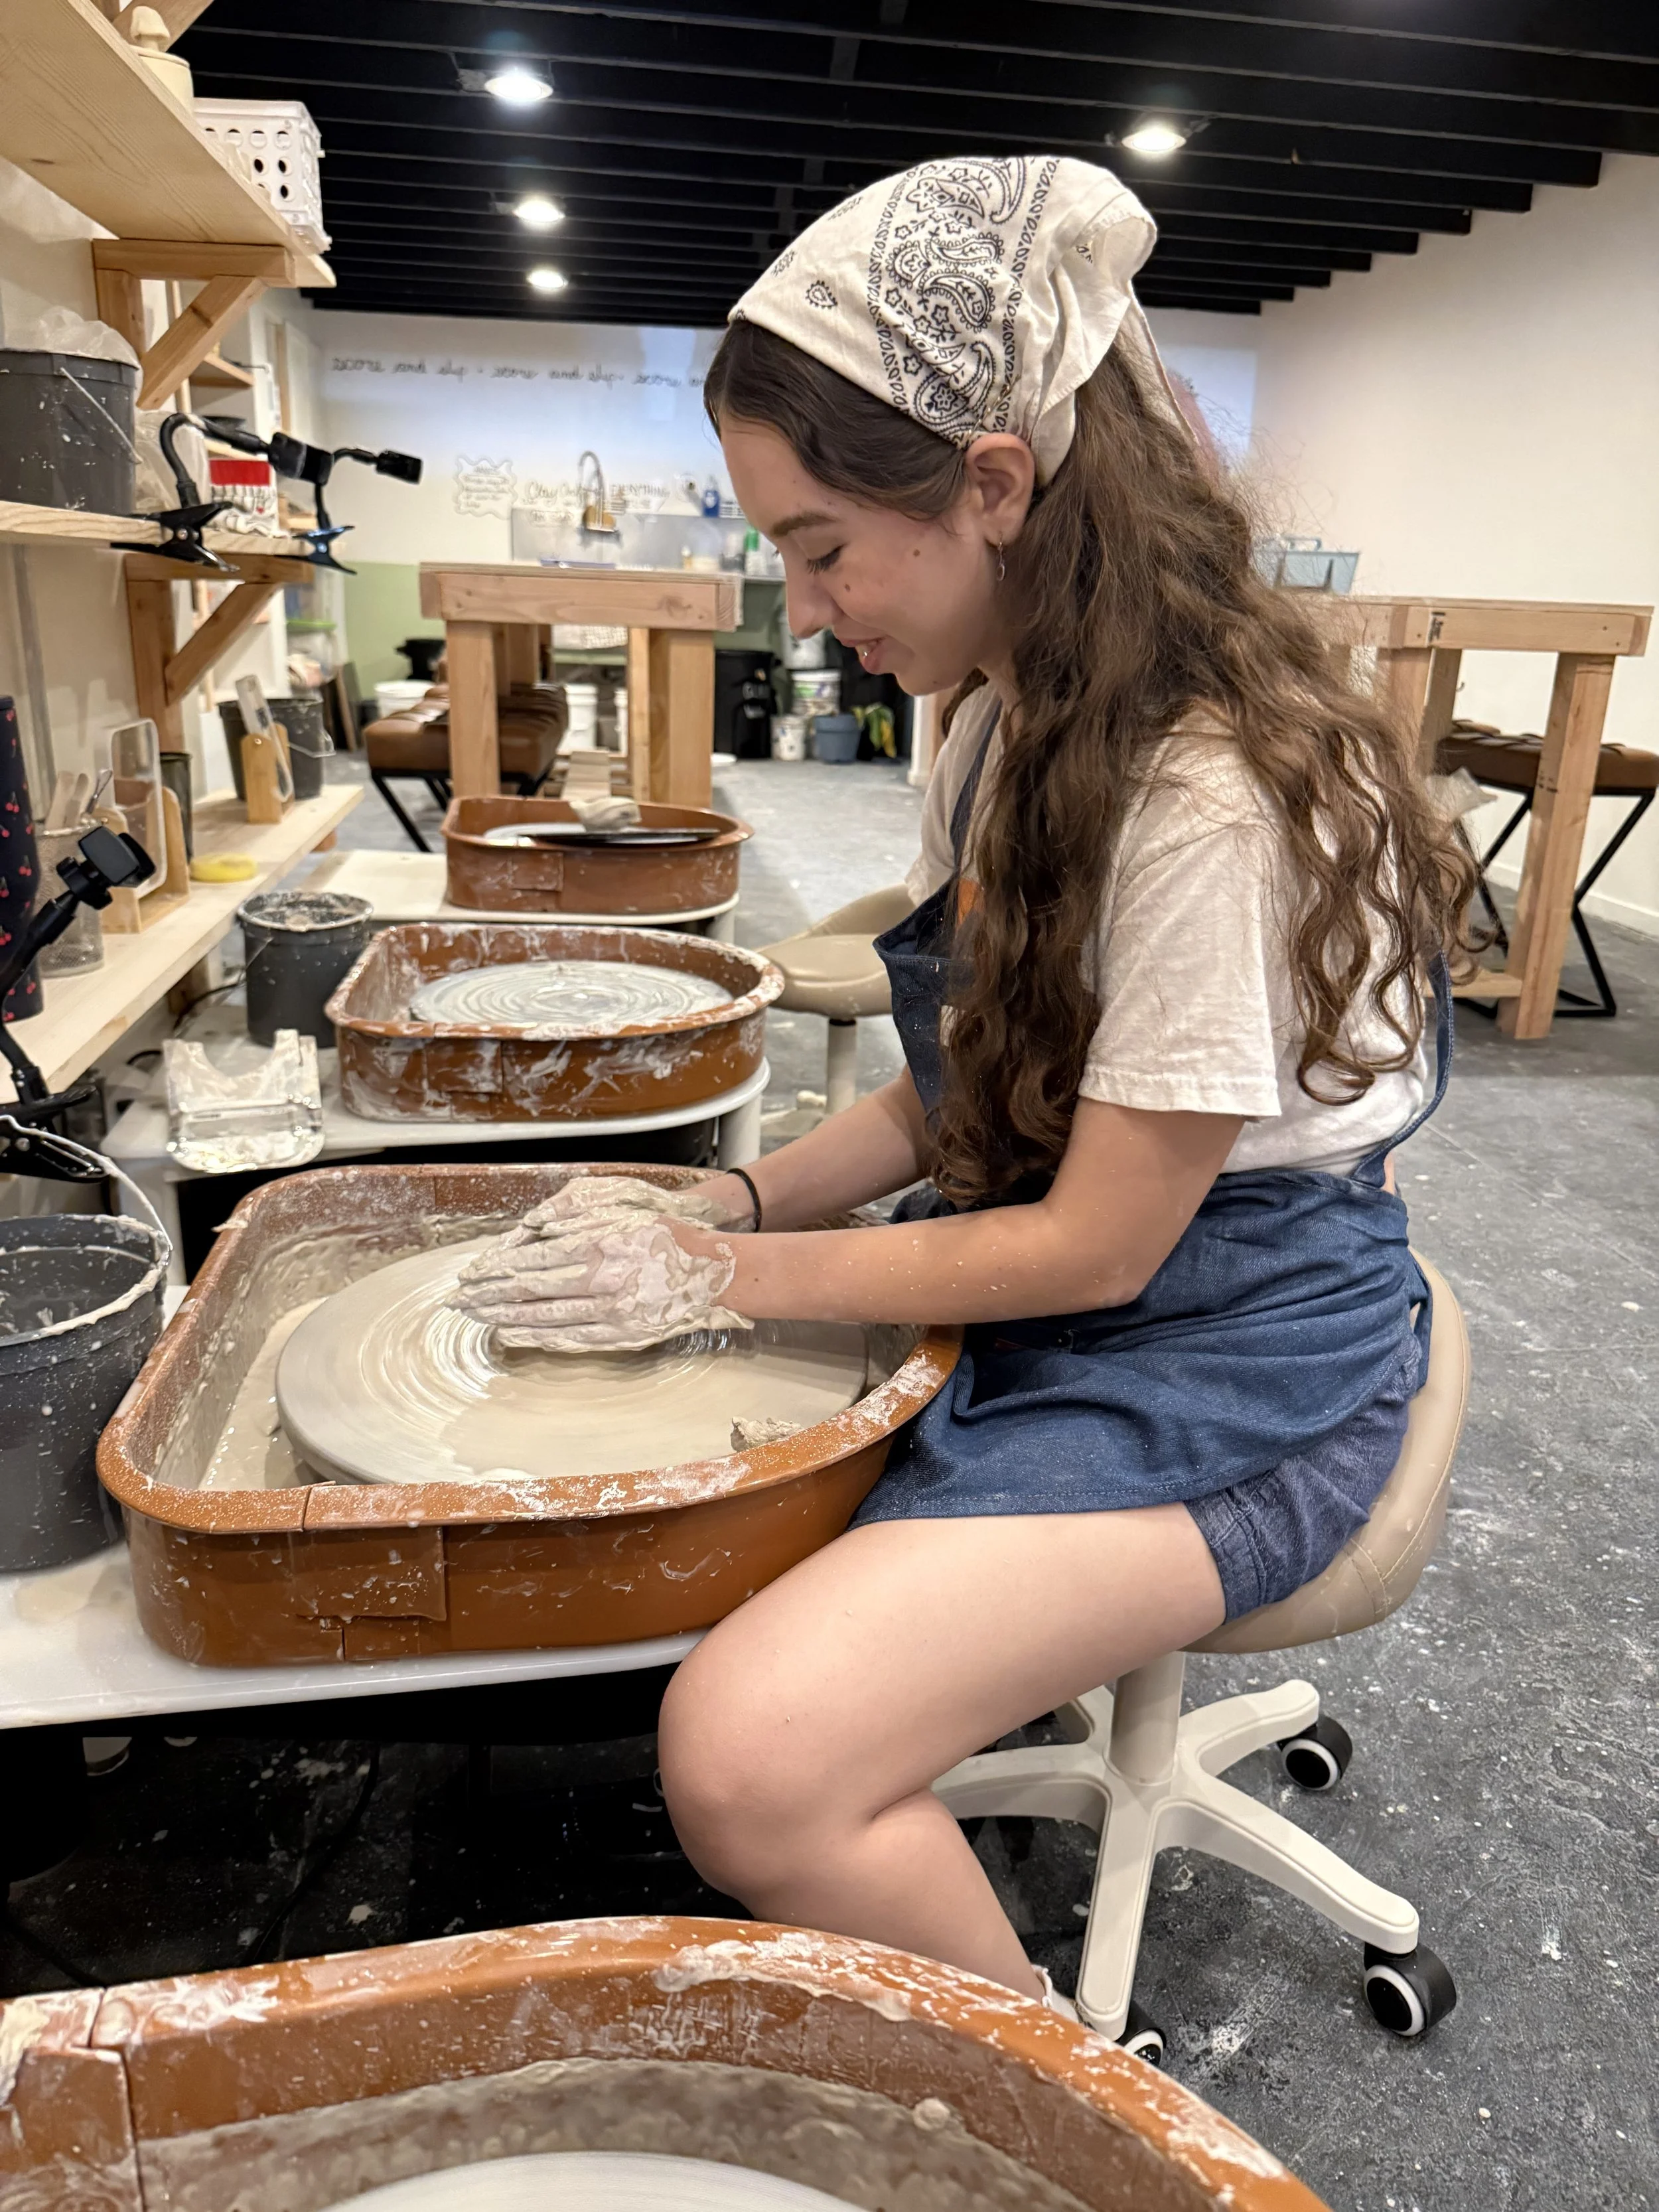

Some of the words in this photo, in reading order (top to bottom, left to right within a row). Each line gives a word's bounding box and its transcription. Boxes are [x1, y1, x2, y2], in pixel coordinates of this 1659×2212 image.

[331, 358, 386, 373] score
[391, 358, 427, 374] and
[547, 364, 584, 380] and
